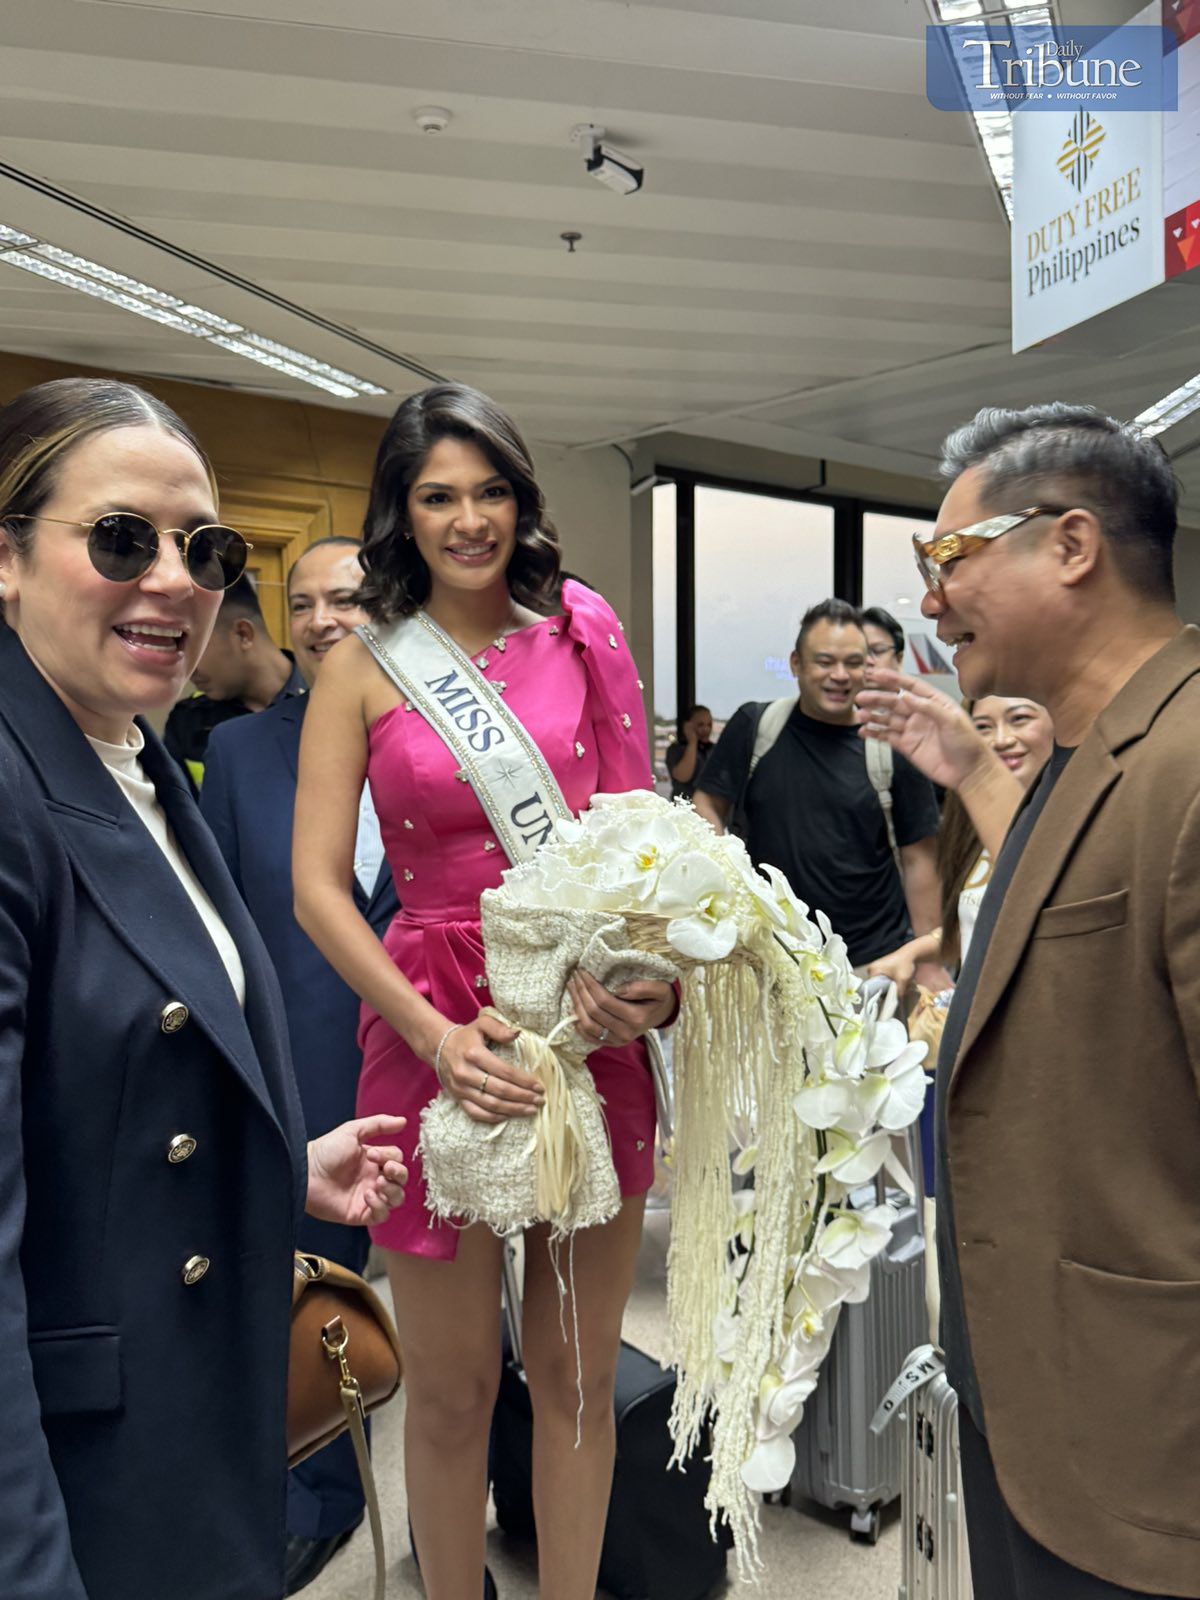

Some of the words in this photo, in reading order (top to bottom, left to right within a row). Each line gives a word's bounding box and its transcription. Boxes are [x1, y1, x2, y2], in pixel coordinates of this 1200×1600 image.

[1027, 203, 1080, 263] DUTY
[1084, 166, 1142, 230] FREE
[1027, 216, 1141, 297] Philippines
[424, 669, 505, 753] MISS
